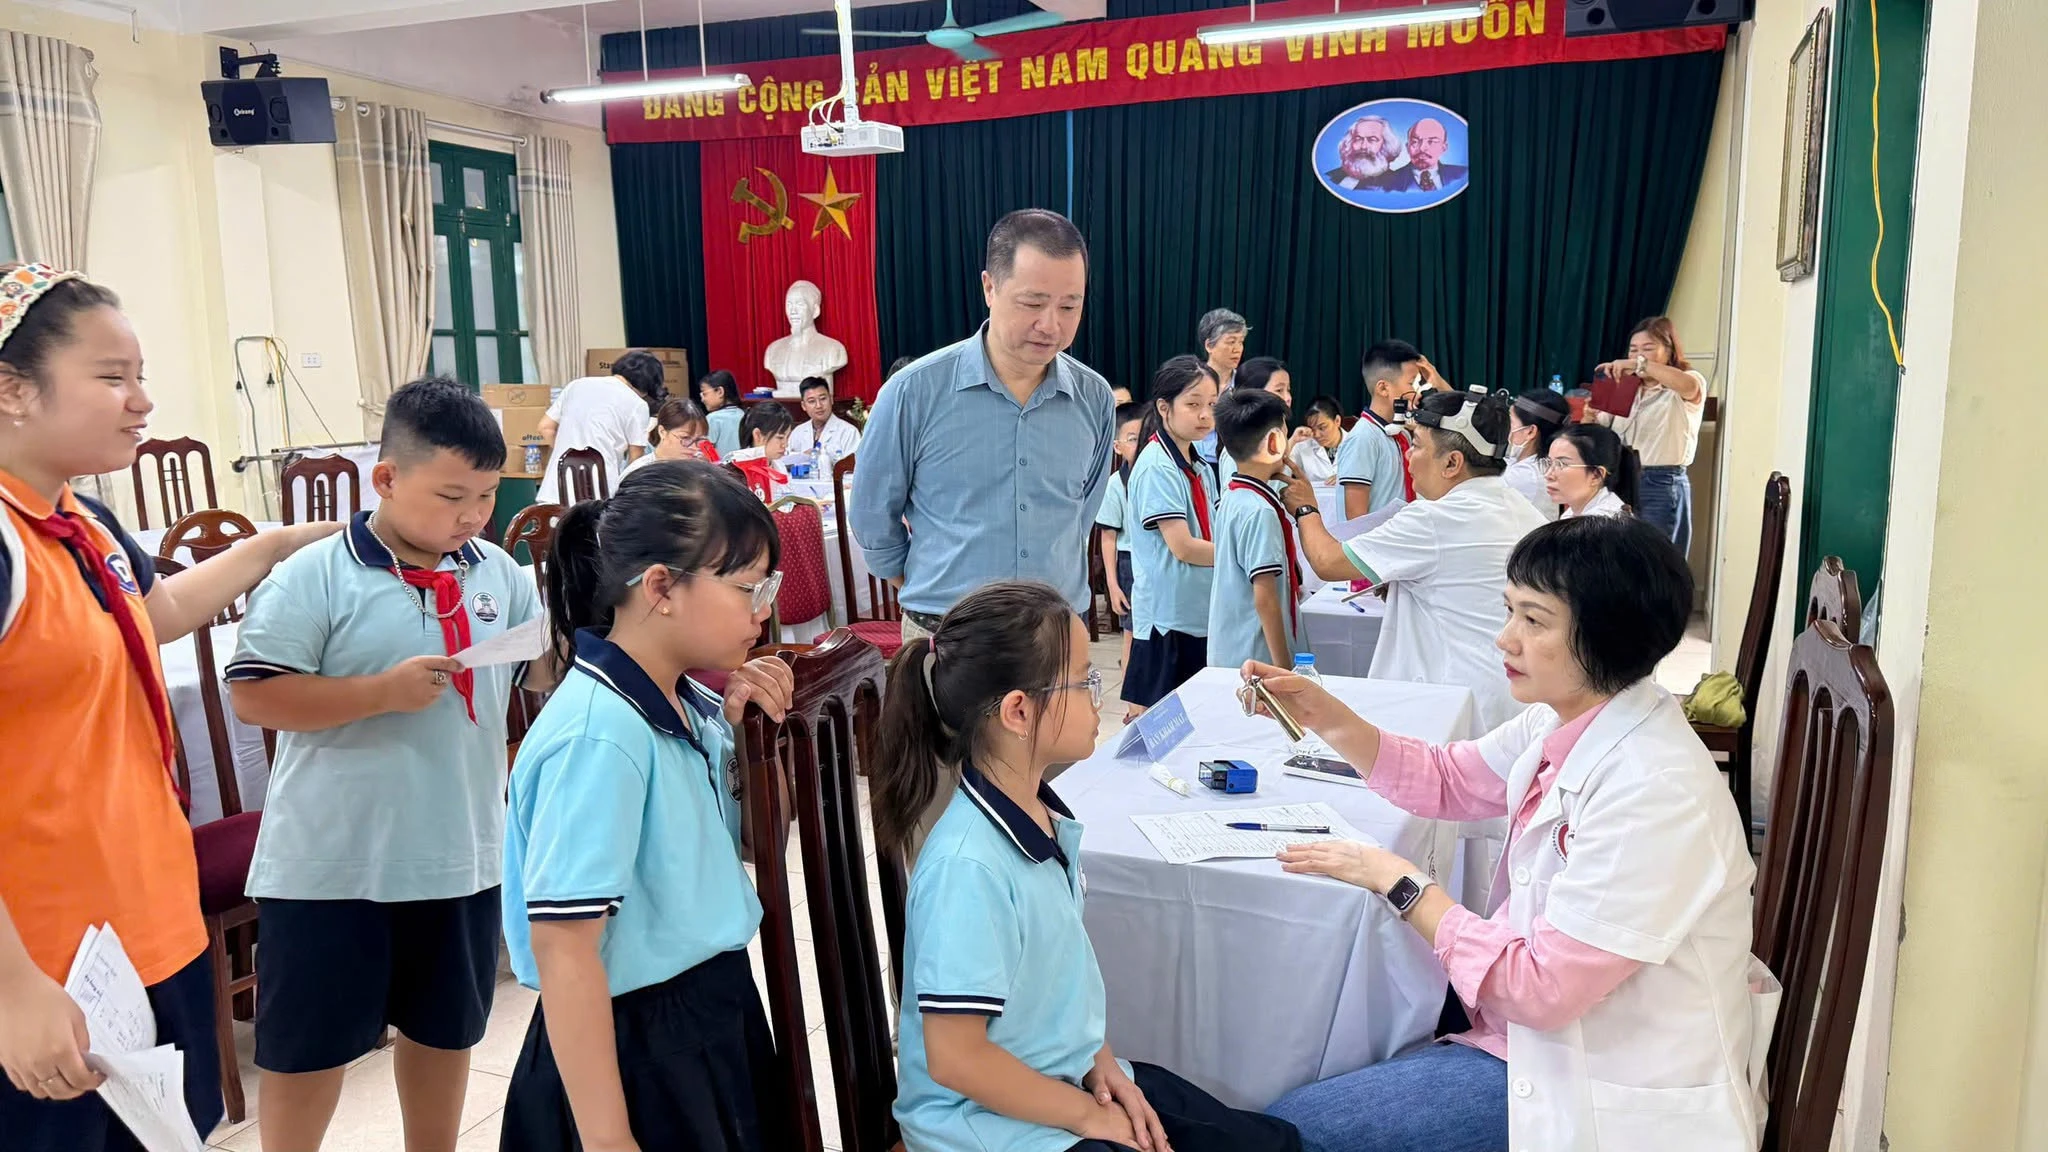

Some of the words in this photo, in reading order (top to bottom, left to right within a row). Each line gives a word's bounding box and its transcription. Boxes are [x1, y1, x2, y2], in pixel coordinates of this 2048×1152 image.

[737, 76, 825, 120] CỘNG
[853, 62, 909, 106] ẢN
[926, 60, 1003, 103] VIỆT
[1020, 47, 1108, 90] NAM
[1126, 36, 1262, 80] QUANG
[1285, 27, 1387, 63] VINH
